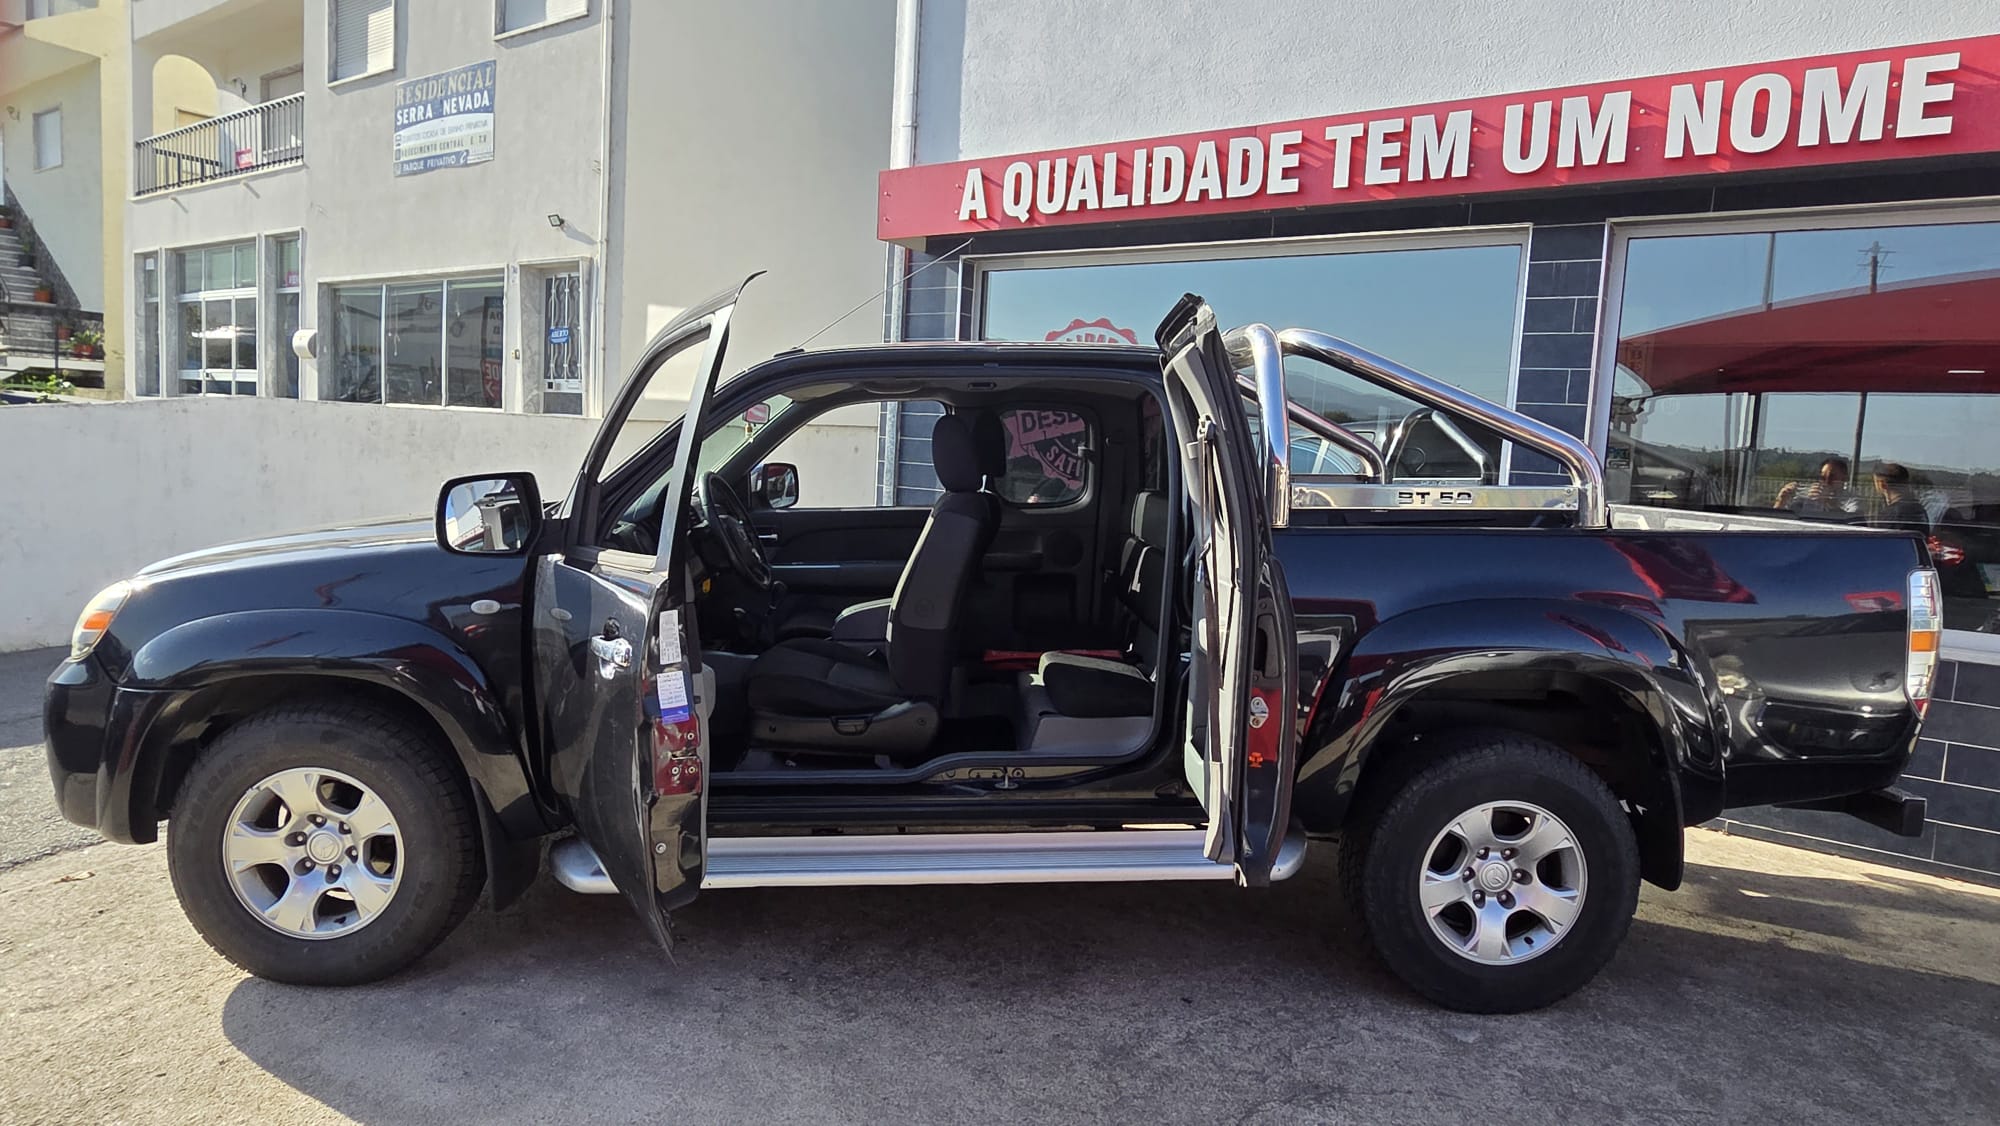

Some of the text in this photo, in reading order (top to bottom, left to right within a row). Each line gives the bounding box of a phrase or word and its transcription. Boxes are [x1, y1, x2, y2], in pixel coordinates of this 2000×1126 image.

[396, 66, 493, 106] RESIDENCIAL
[396, 90, 490, 126] SERRA NEVADA
[958, 51, 1961, 223] A QUALIDADE TEM UM NOME
[403, 160, 424, 171] PARQUE
